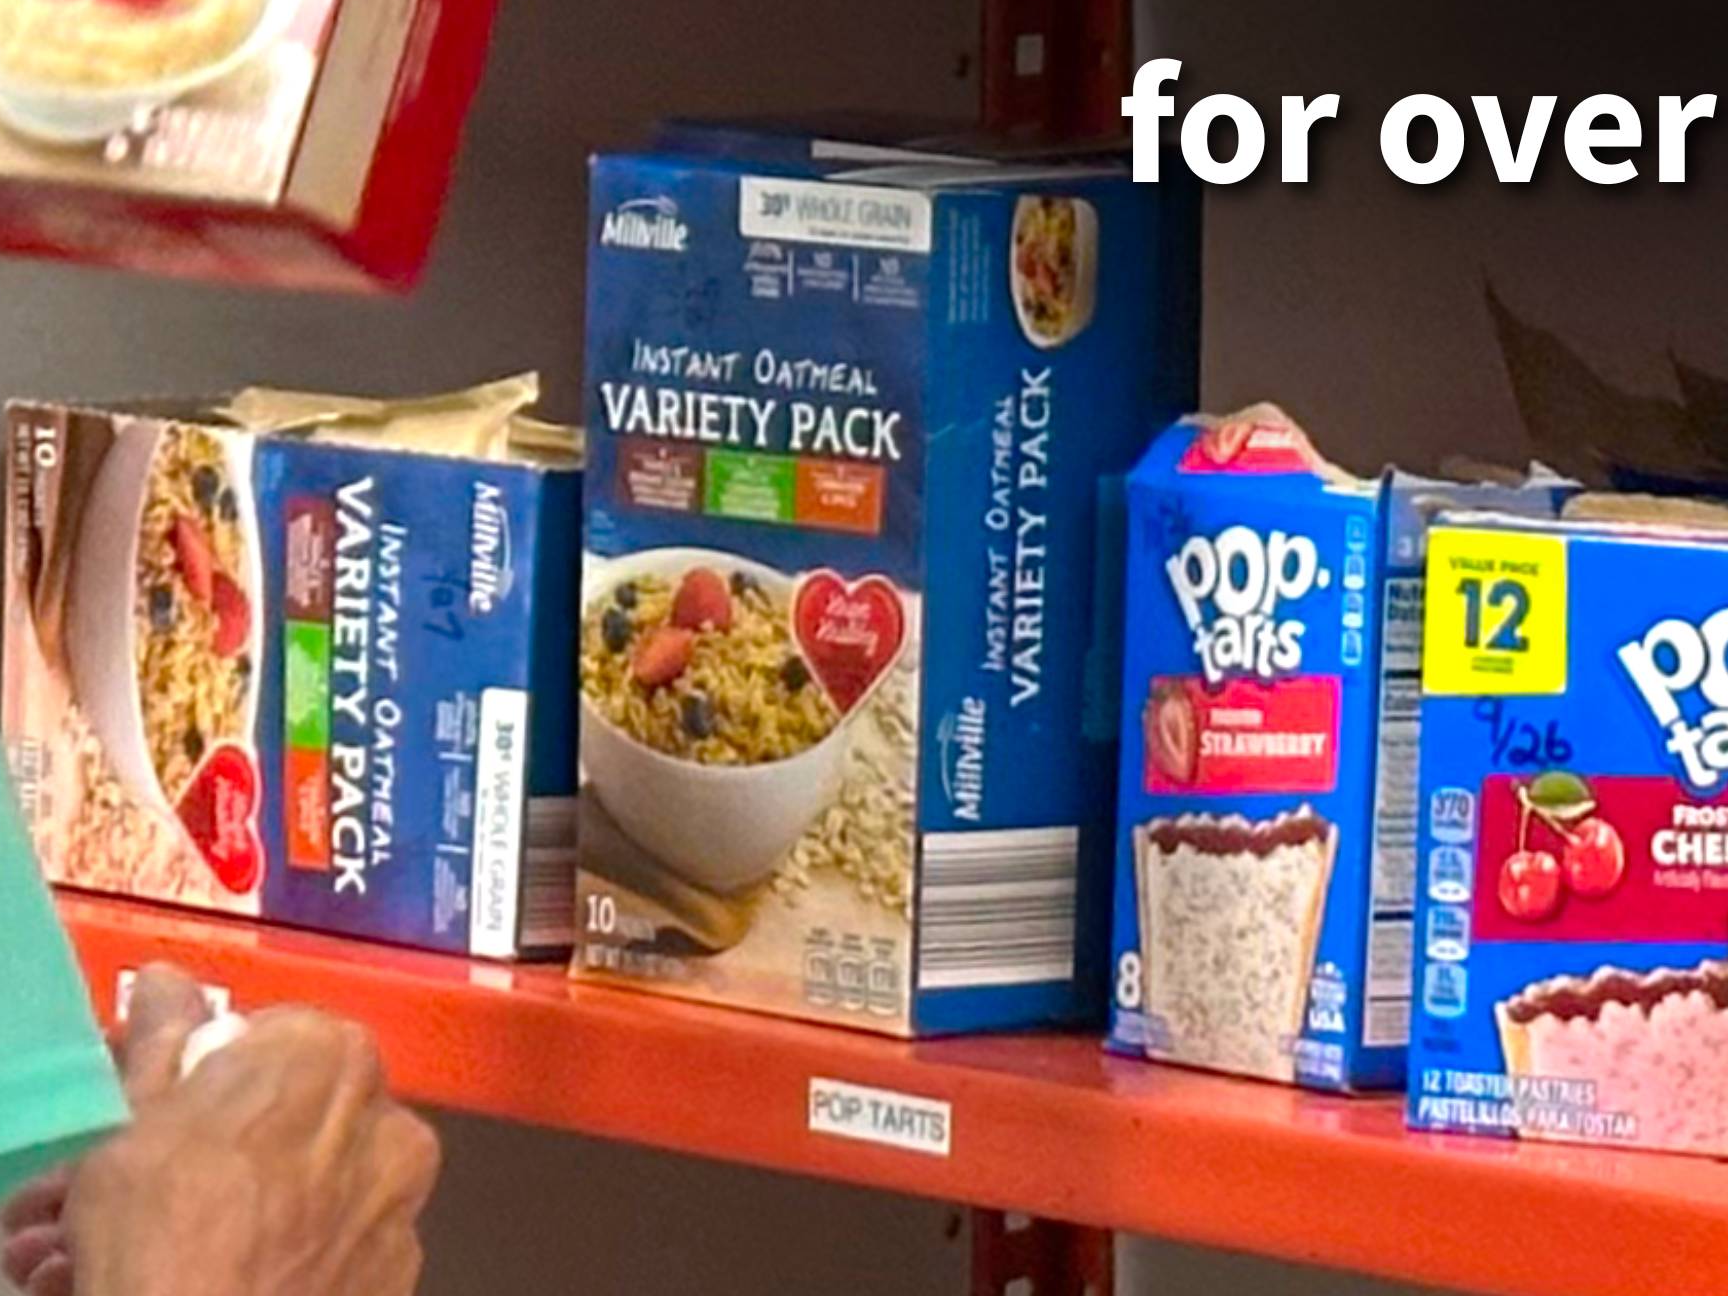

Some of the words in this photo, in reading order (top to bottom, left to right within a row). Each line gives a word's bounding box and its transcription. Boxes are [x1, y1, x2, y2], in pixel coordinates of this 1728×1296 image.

[601, 209, 689, 251] Millville
[796, 193, 854, 225] WHOLE
[859, 198, 912, 232] GRAIN
[632, 338, 741, 384] INSTANT
[754, 349, 878, 395] OATMEAL
[34, 425, 57, 468] 10
[601, 384, 775, 448] VARIETY
[789, 406, 902, 460] PACK
[1017, 366, 1053, 488] PACK
[985, 395, 1014, 532] OATMEAL
[470, 481, 504, 613] Millville
[1448, 557, 1496, 573] VALUE
[1500, 561, 1540, 577] PACK
[332, 476, 374, 728] VARIETY
[375, 521, 409, 682] INSTANT
[981, 553, 1009, 671] INSTANT
[1011, 507, 1049, 707] VARIETY
[1455, 577, 1531, 653] 12
[1193, 614, 1307, 686] tarts
[954, 697, 988, 822] Millville
[1199, 729, 1327, 760] STRAWBERRY
[1472, 696, 1573, 768] 9/26
[370, 698, 403, 865] OATMEAL
[490, 764, 515, 850] WHOLE
[1434, 792, 1471, 816] 370
[331, 744, 367, 896] PACK
[485, 856, 506, 934] GRAIN
[585, 896, 616, 932] 10
[1115, 951, 1142, 1008] 8
[1309, 1010, 1346, 1034] USA
[813, 1090, 861, 1122] POP
[868, 1103, 946, 1144] TARTS
[1421, 1070, 1442, 1092] 12
[1445, 1071, 1513, 1100] TOASTER
[1518, 1079, 1596, 1107] PASTRIES
[1526, 1109, 1569, 1132] PARA
[1575, 1112, 1637, 1137] TOSTAR
